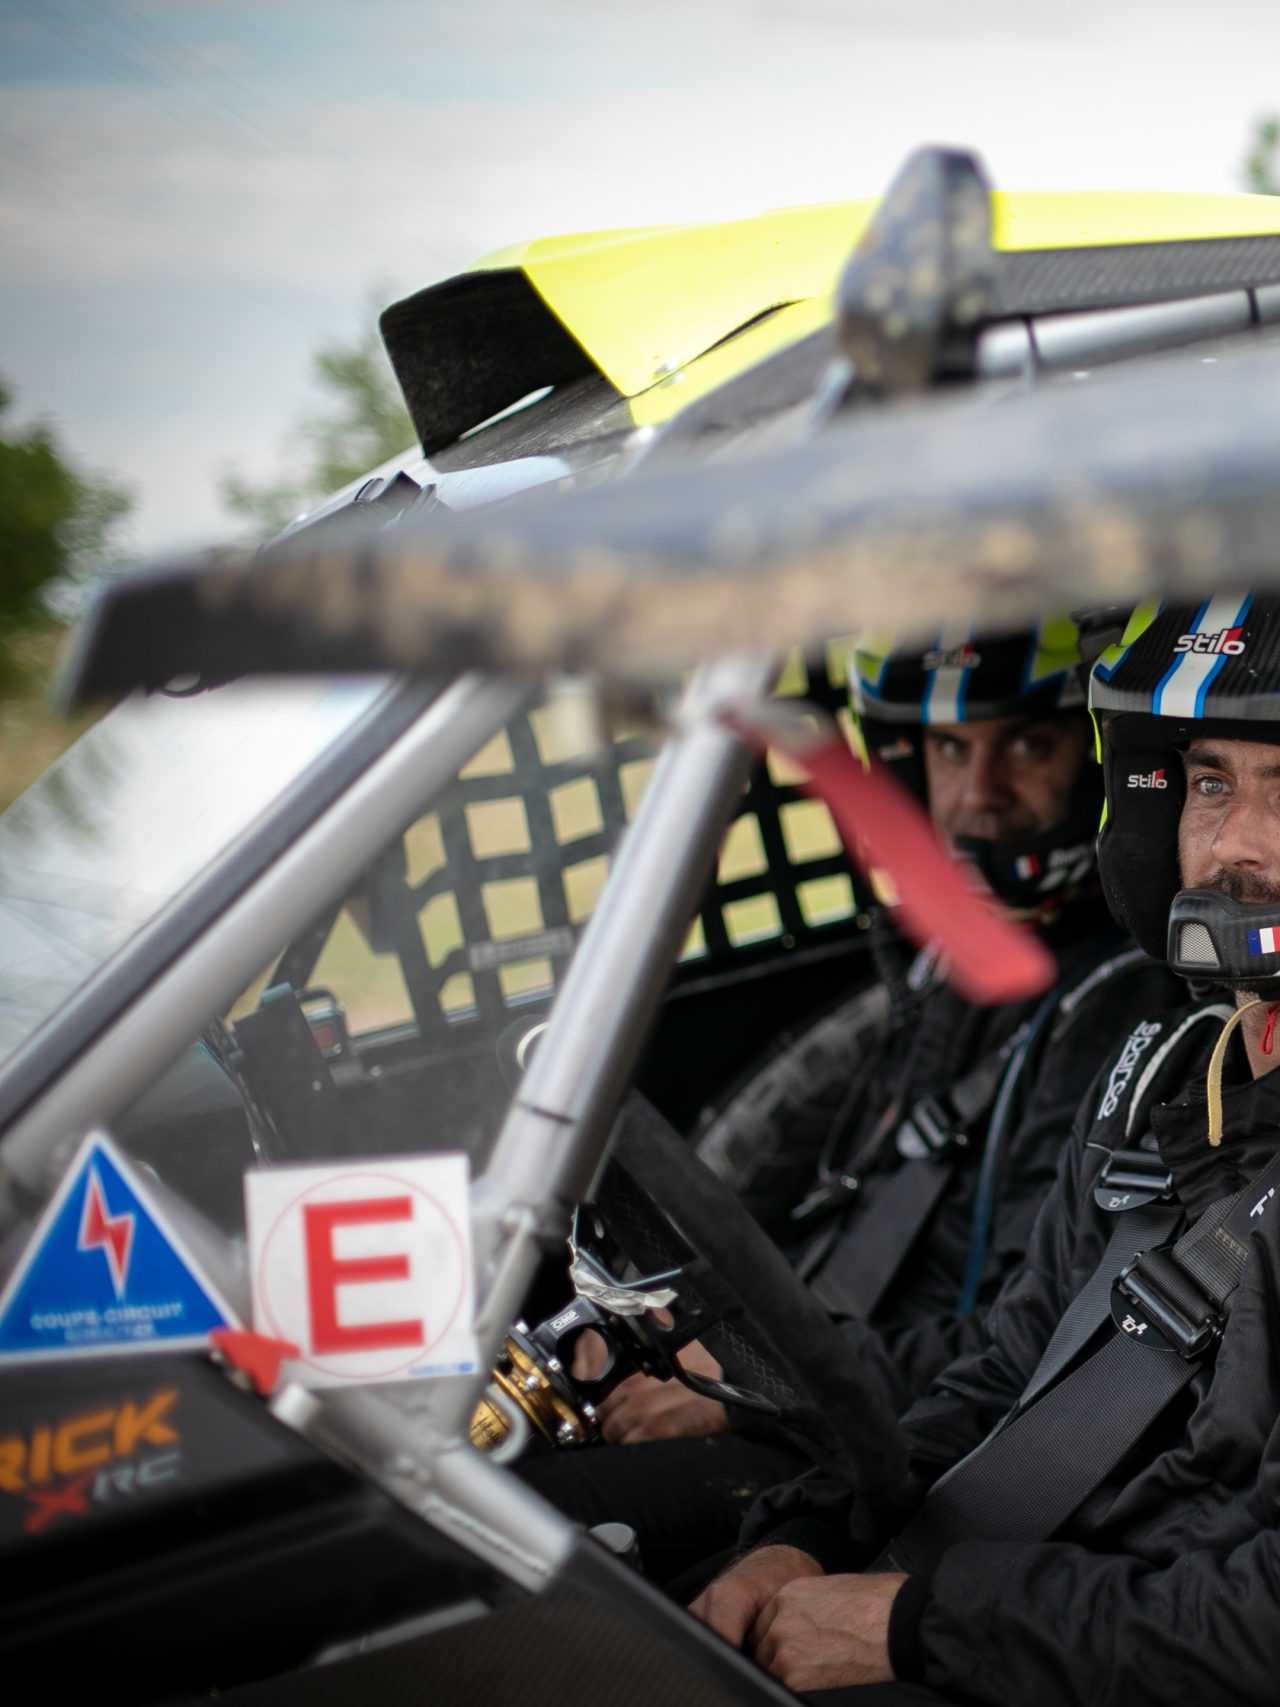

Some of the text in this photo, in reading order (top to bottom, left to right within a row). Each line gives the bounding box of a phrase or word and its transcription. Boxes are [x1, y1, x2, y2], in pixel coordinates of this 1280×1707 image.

[1174, 626, 1246, 656] Stilo
[1127, 768, 1168, 790] Stilo
[303, 1195, 425, 1357] E
